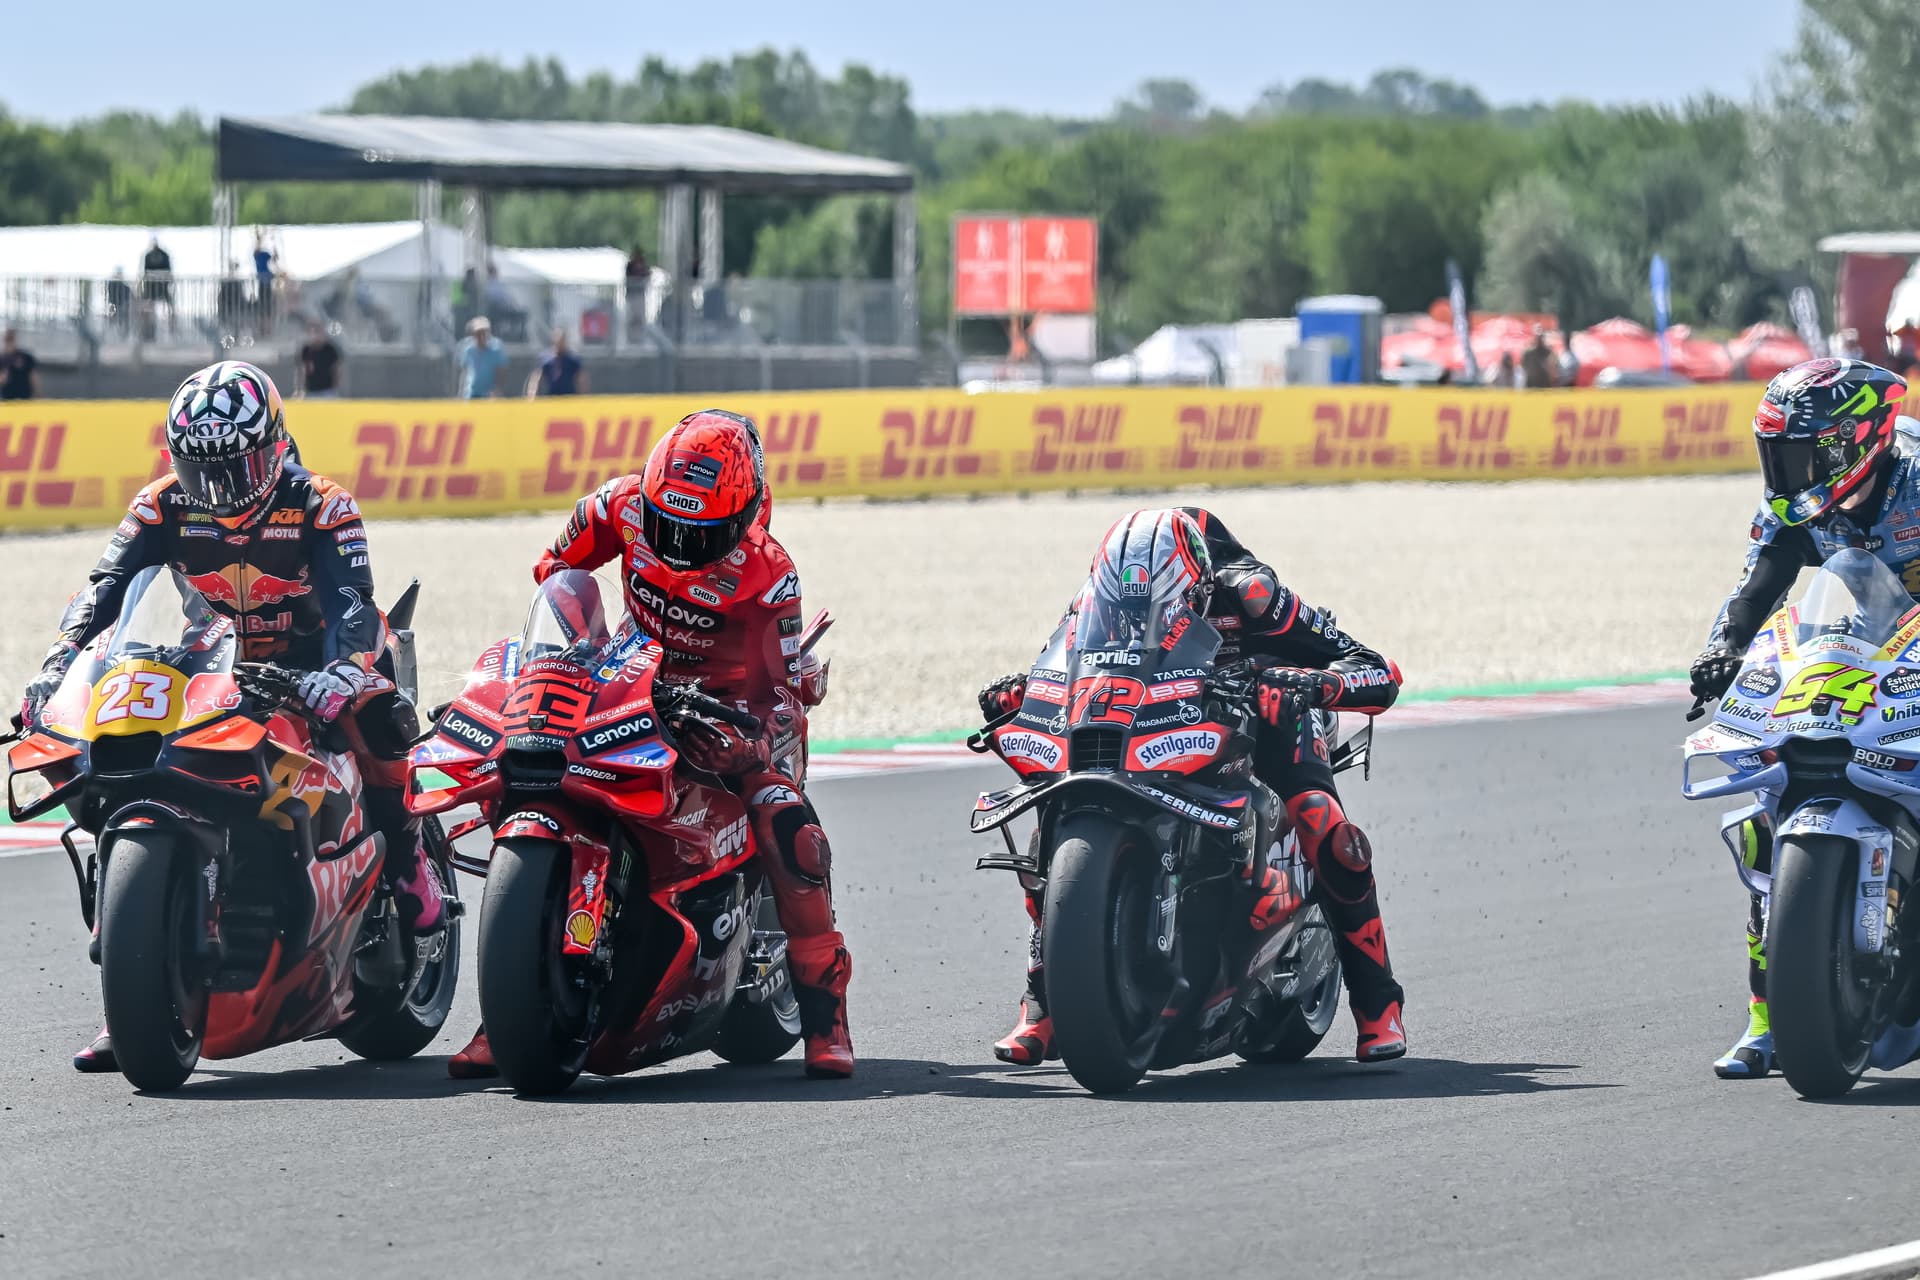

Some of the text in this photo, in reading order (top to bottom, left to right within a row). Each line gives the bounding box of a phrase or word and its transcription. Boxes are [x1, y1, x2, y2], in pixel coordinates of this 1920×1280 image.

[881, 409, 980, 479] DHL
[1031, 404, 1125, 473] DHL
[1174, 403, 1267, 470] DHL
[1311, 403, 1399, 467] DHL
[1435, 405, 1512, 467] DHL
[1551, 405, 1625, 467] DHL
[227, 446, 256, 459] WINGS
[353, 421, 480, 502] DHL
[690, 463, 715, 477] Lenovo
[1837, 442, 1879, 489] LS2
[667, 493, 699, 511] SHOEI
[263, 527, 300, 539] MOTUL
[692, 587, 718, 604] SHOEI
[1124, 583, 1146, 595] agv
[630, 573, 715, 629] Lenovo
[246, 611, 292, 632] Bull
[200, 616, 233, 647] MOTUL
[1081, 650, 1141, 666] aprilia
[1819, 642, 1863, 655] GLOBAL
[1031, 669, 1066, 682] TARGA
[1154, 668, 1207, 682] TARGA
[96, 672, 172, 725] 23
[1028, 683, 1065, 698] BS
[1150, 681, 1200, 699] BS
[1772, 661, 1878, 718] 54
[585, 698, 649, 725] FRECCIAROSSA
[1068, 674, 1147, 730] 72
[1720, 697, 1769, 722] Unibat
[1017, 711, 1050, 727] PRAGMATIC
[1136, 715, 1181, 729] PRAGMATIC
[1181, 711, 1200, 720] PLAY
[1881, 704, 1920, 722] Unib
[443, 711, 495, 748] Lenovo
[581, 716, 654, 750] Lenovo
[1880, 729, 1920, 744] MS GLOW
[517, 733, 566, 747] MONSTER
[1001, 733, 1058, 764] sterilgarda
[1140, 732, 1216, 764] sterilgarda
[634, 755, 661, 766] TIM
[1855, 748, 1896, 767] BOLD
[568, 764, 617, 781] CARRERA
